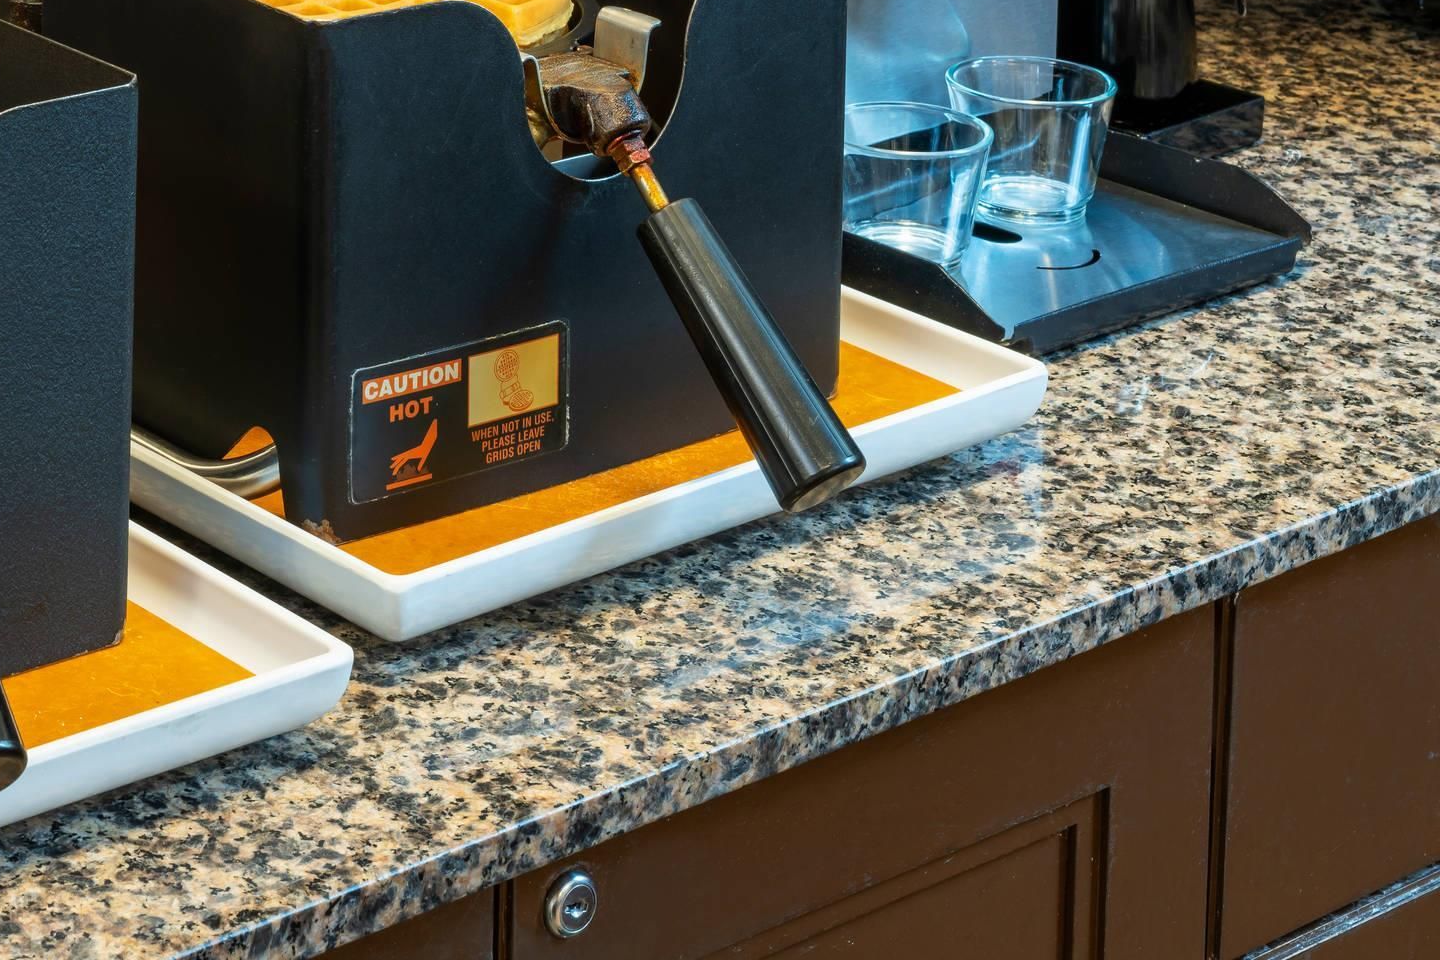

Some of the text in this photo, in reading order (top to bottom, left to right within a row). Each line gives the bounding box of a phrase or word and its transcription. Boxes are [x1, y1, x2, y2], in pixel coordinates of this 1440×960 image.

[364, 362, 459, 401] CAUTION
[390, 396, 433, 423] HOT
[471, 425, 499, 442] WHEN
[502, 420, 520, 434] NOT
[523, 415, 532, 428] IN
[482, 425, 545, 453] PLEASE LEAVE
[486, 440, 541, 464] GRIDS OPEN
